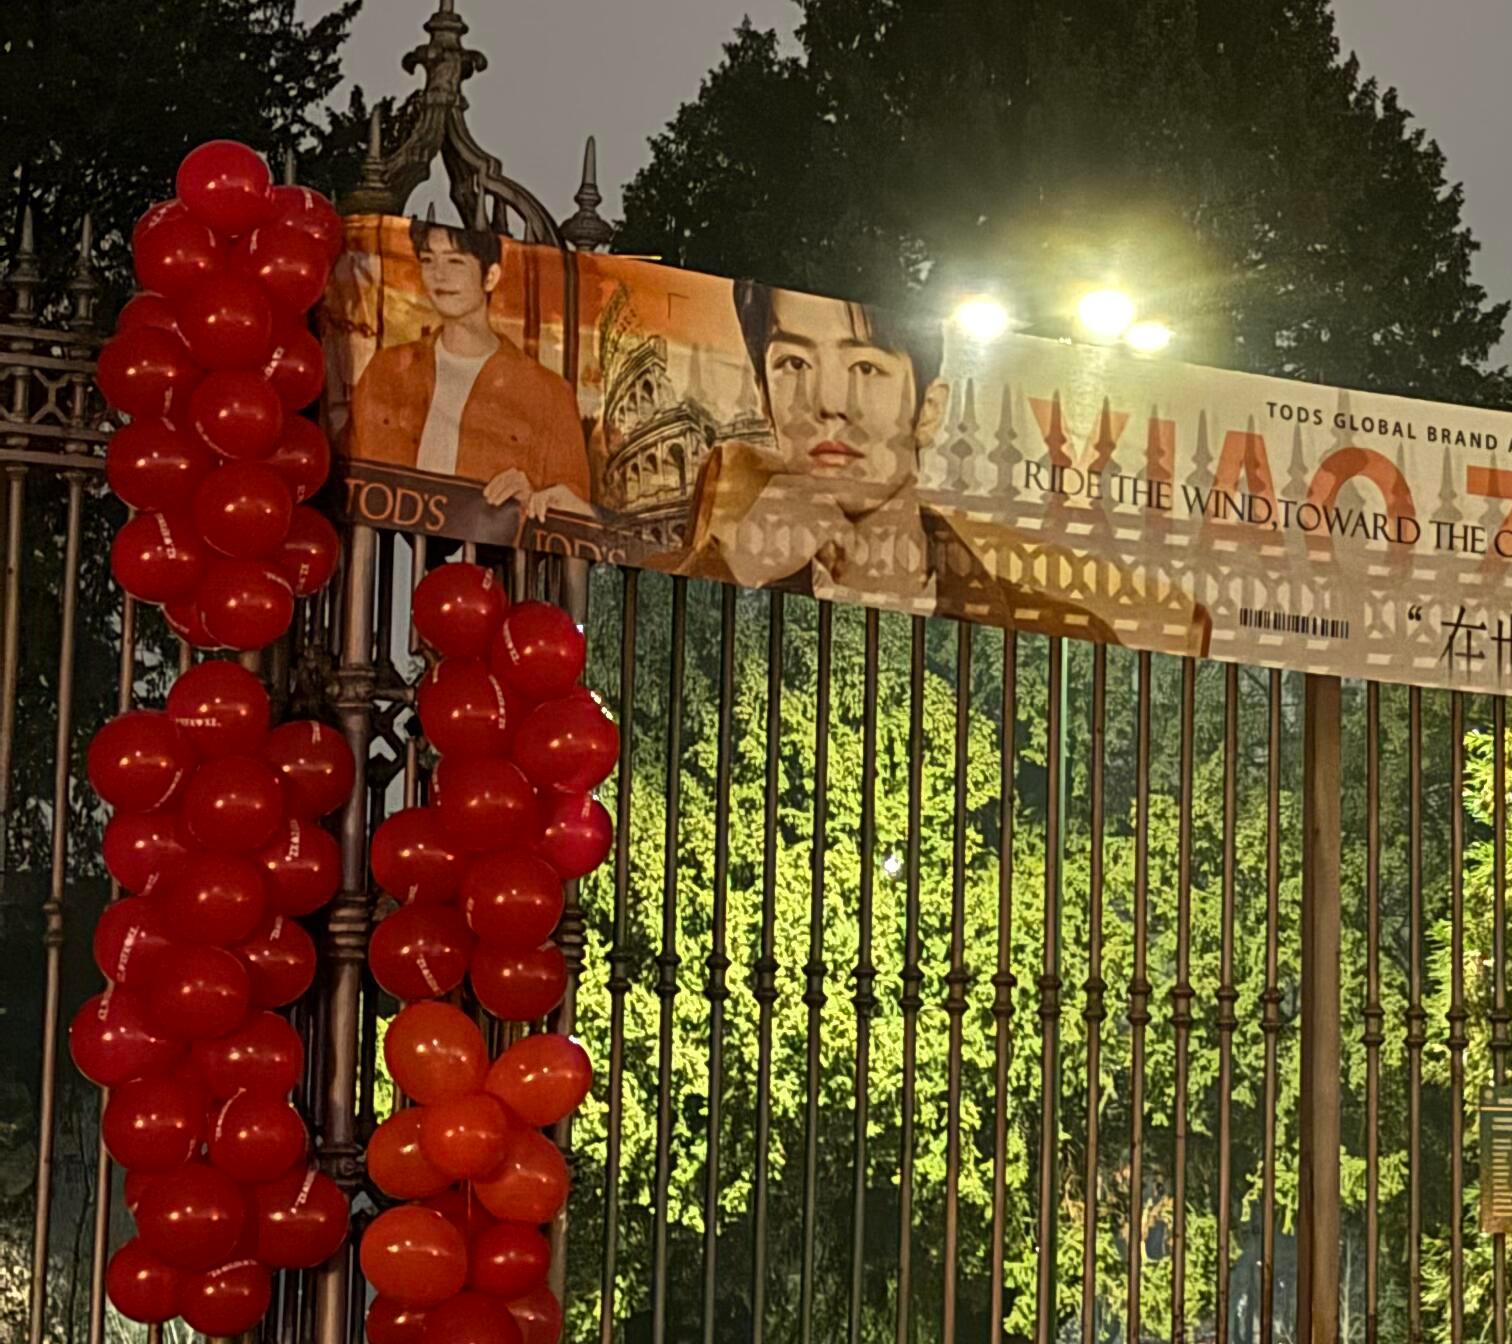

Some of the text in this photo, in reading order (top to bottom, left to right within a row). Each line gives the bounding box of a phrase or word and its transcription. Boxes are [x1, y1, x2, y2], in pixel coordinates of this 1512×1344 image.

[1265, 400, 1324, 426] TODS
[1333, 412, 1417, 440] GLOBAL
[1426, 425, 1499, 451] BRAND
[1023, 459, 1103, 501] RIDE
[1111, 472, 1174, 511] THE
[1428, 518, 1487, 555] THE
[1028, 398, 1419, 588] XIAO
